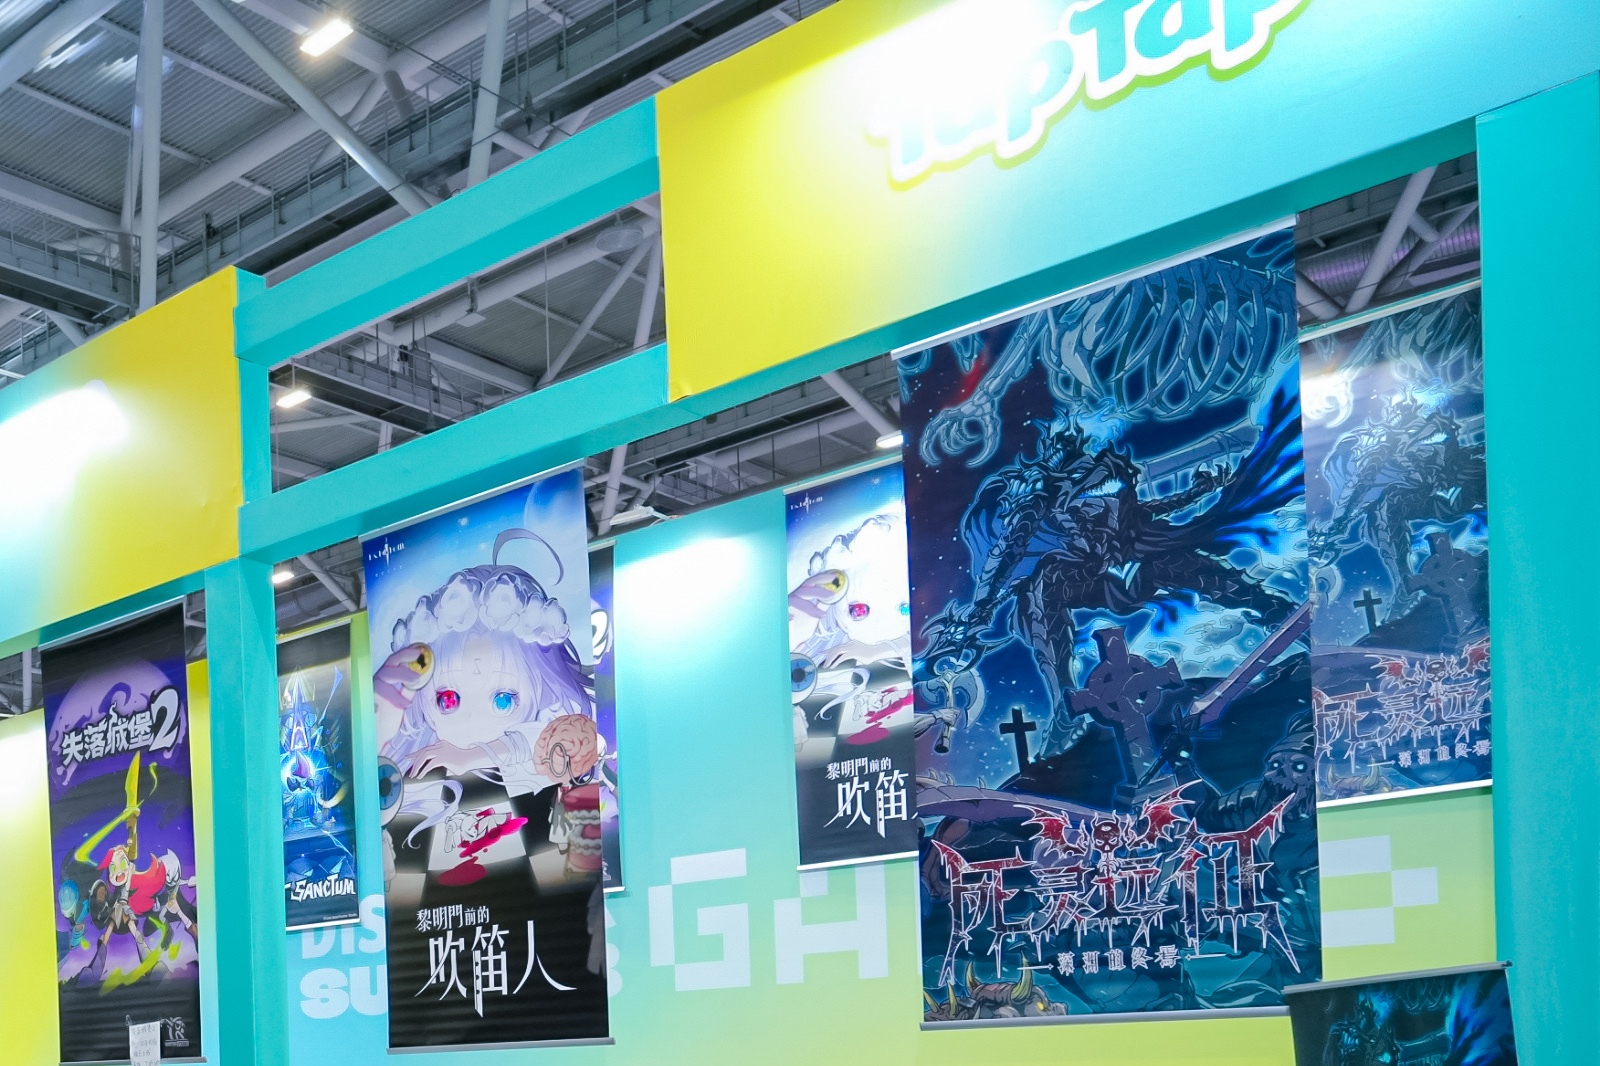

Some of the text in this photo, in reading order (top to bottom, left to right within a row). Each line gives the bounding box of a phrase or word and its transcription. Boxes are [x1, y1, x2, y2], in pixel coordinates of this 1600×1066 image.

[60, 687, 180, 767] 失落城堡2
[1312, 680, 1492, 782] 死灵远
[825, 757, 892, 780] 黎明門前的
[823, 769, 918, 838] 吹笛
[291, 873, 356, 902] SANCTUM
[415, 904, 490, 933] 黎明門前的
[414, 920, 578, 1018] 吹笛人
